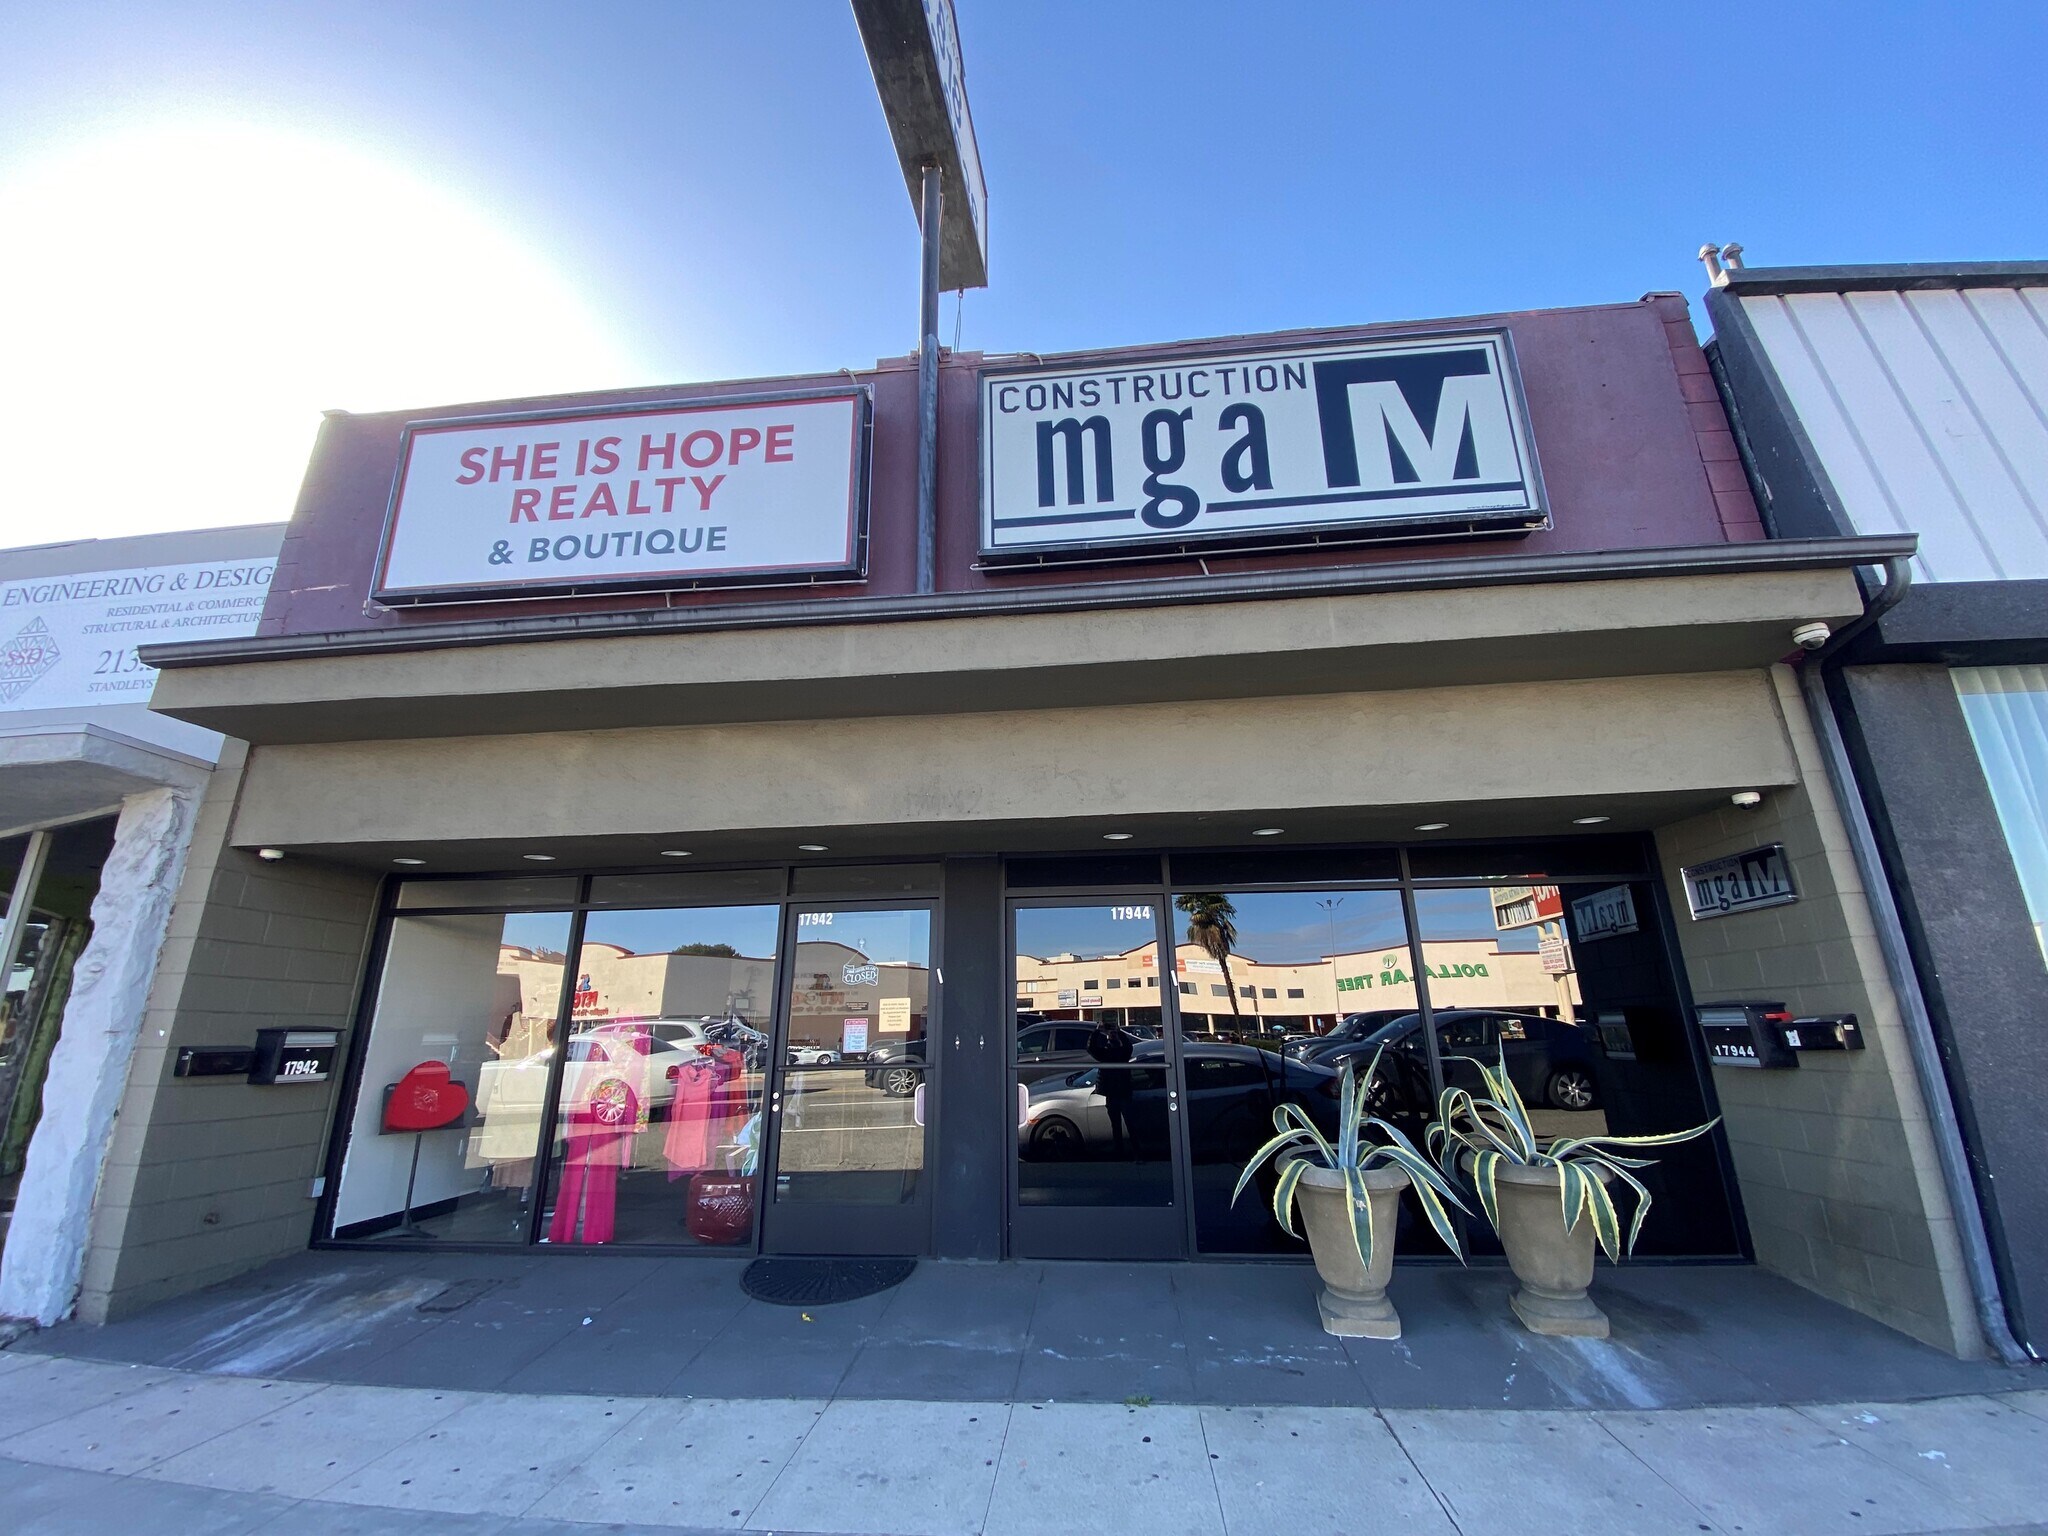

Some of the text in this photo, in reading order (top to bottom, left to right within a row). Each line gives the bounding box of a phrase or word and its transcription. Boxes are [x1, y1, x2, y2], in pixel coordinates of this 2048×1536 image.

[999, 362, 1308, 413] CONSTRUCTION
[456, 426, 795, 485] SHE IS HOPE
[509, 474, 726, 523] REALTY
[488, 526, 728, 565] & BOUTIQUE
[2, 566, 274, 607] ENGINEERING & DESIG
[106, 602, 183, 618] RESIDENTIAL
[185, 600, 195, 611] &
[82, 619, 159, 635] STRUCTURAL
[162, 617, 171, 629] &
[1687, 857, 1740, 878] CONSTRUCTION
[799, 912, 833, 926] 17942
[1110, 906, 1150, 920] 17944
[845, 971, 877, 982] CLOSED
[1715, 1044, 1755, 1057] 17944
[284, 1060, 319, 1075] 17942
